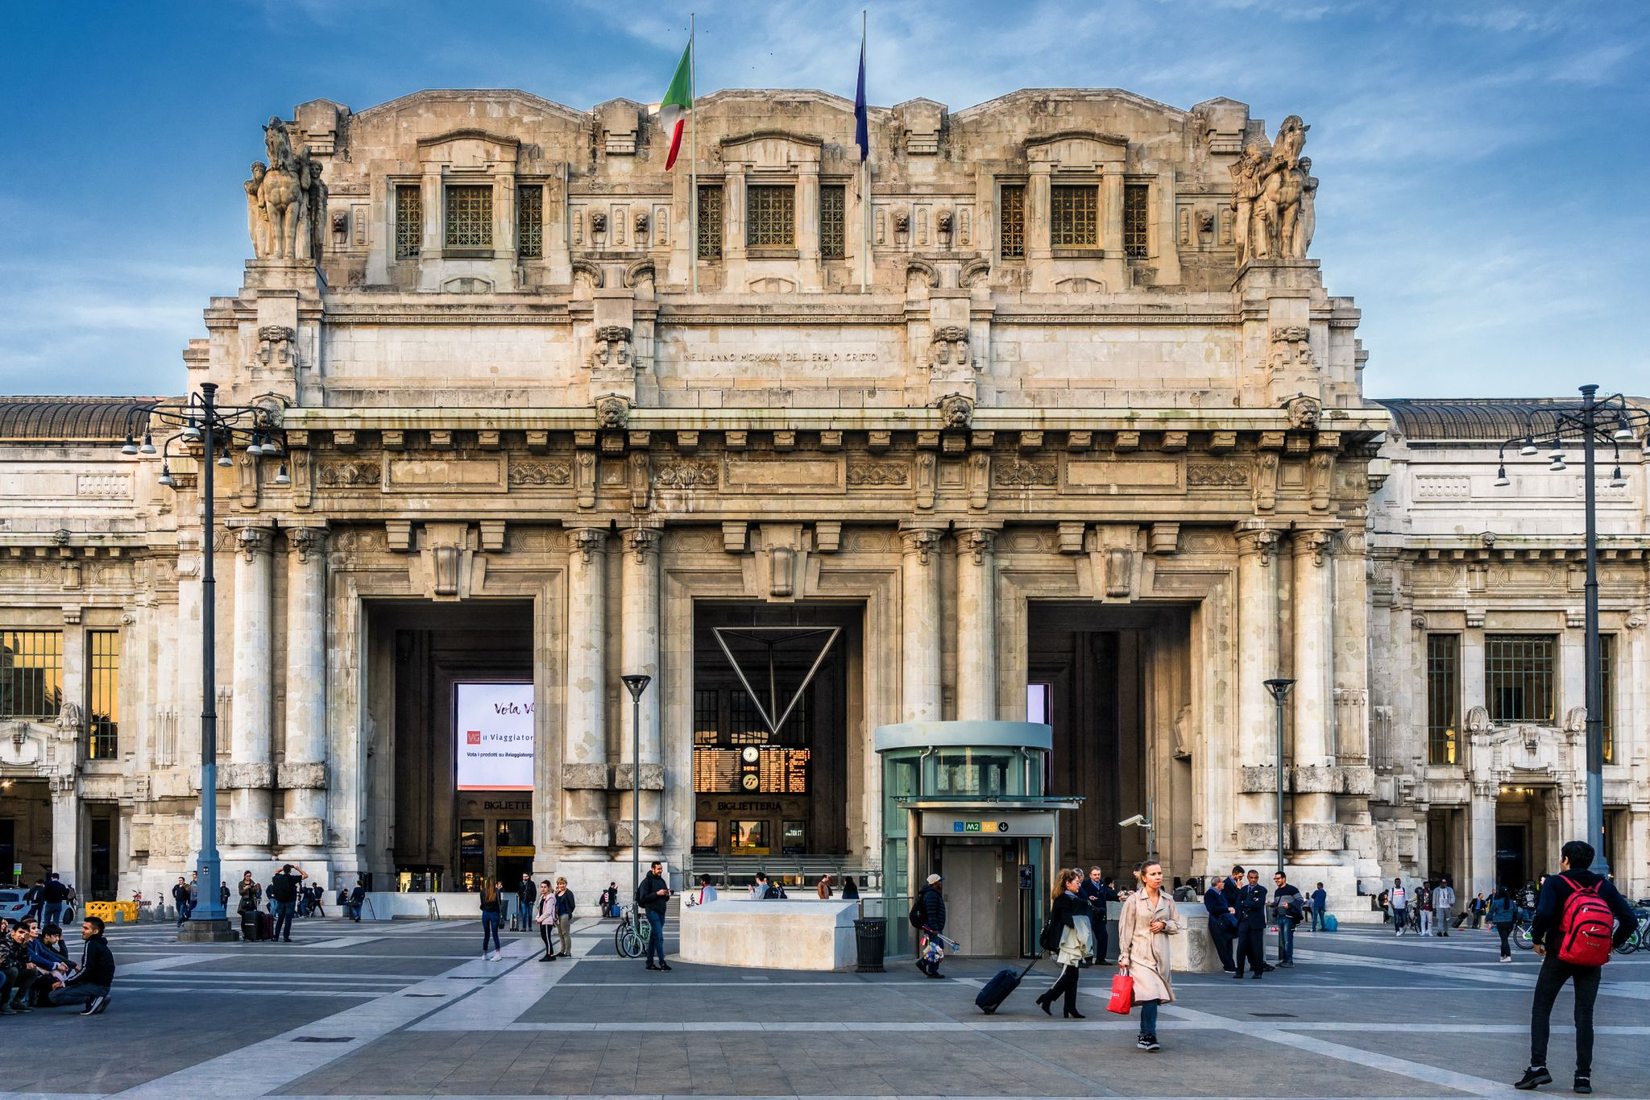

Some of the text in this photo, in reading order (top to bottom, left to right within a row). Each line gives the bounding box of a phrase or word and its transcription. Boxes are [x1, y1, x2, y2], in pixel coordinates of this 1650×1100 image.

[490, 734, 534, 742] Viaggiator
[717, 802, 782, 811] BIGLIETTERIA
[966, 823, 979, 831] M2
